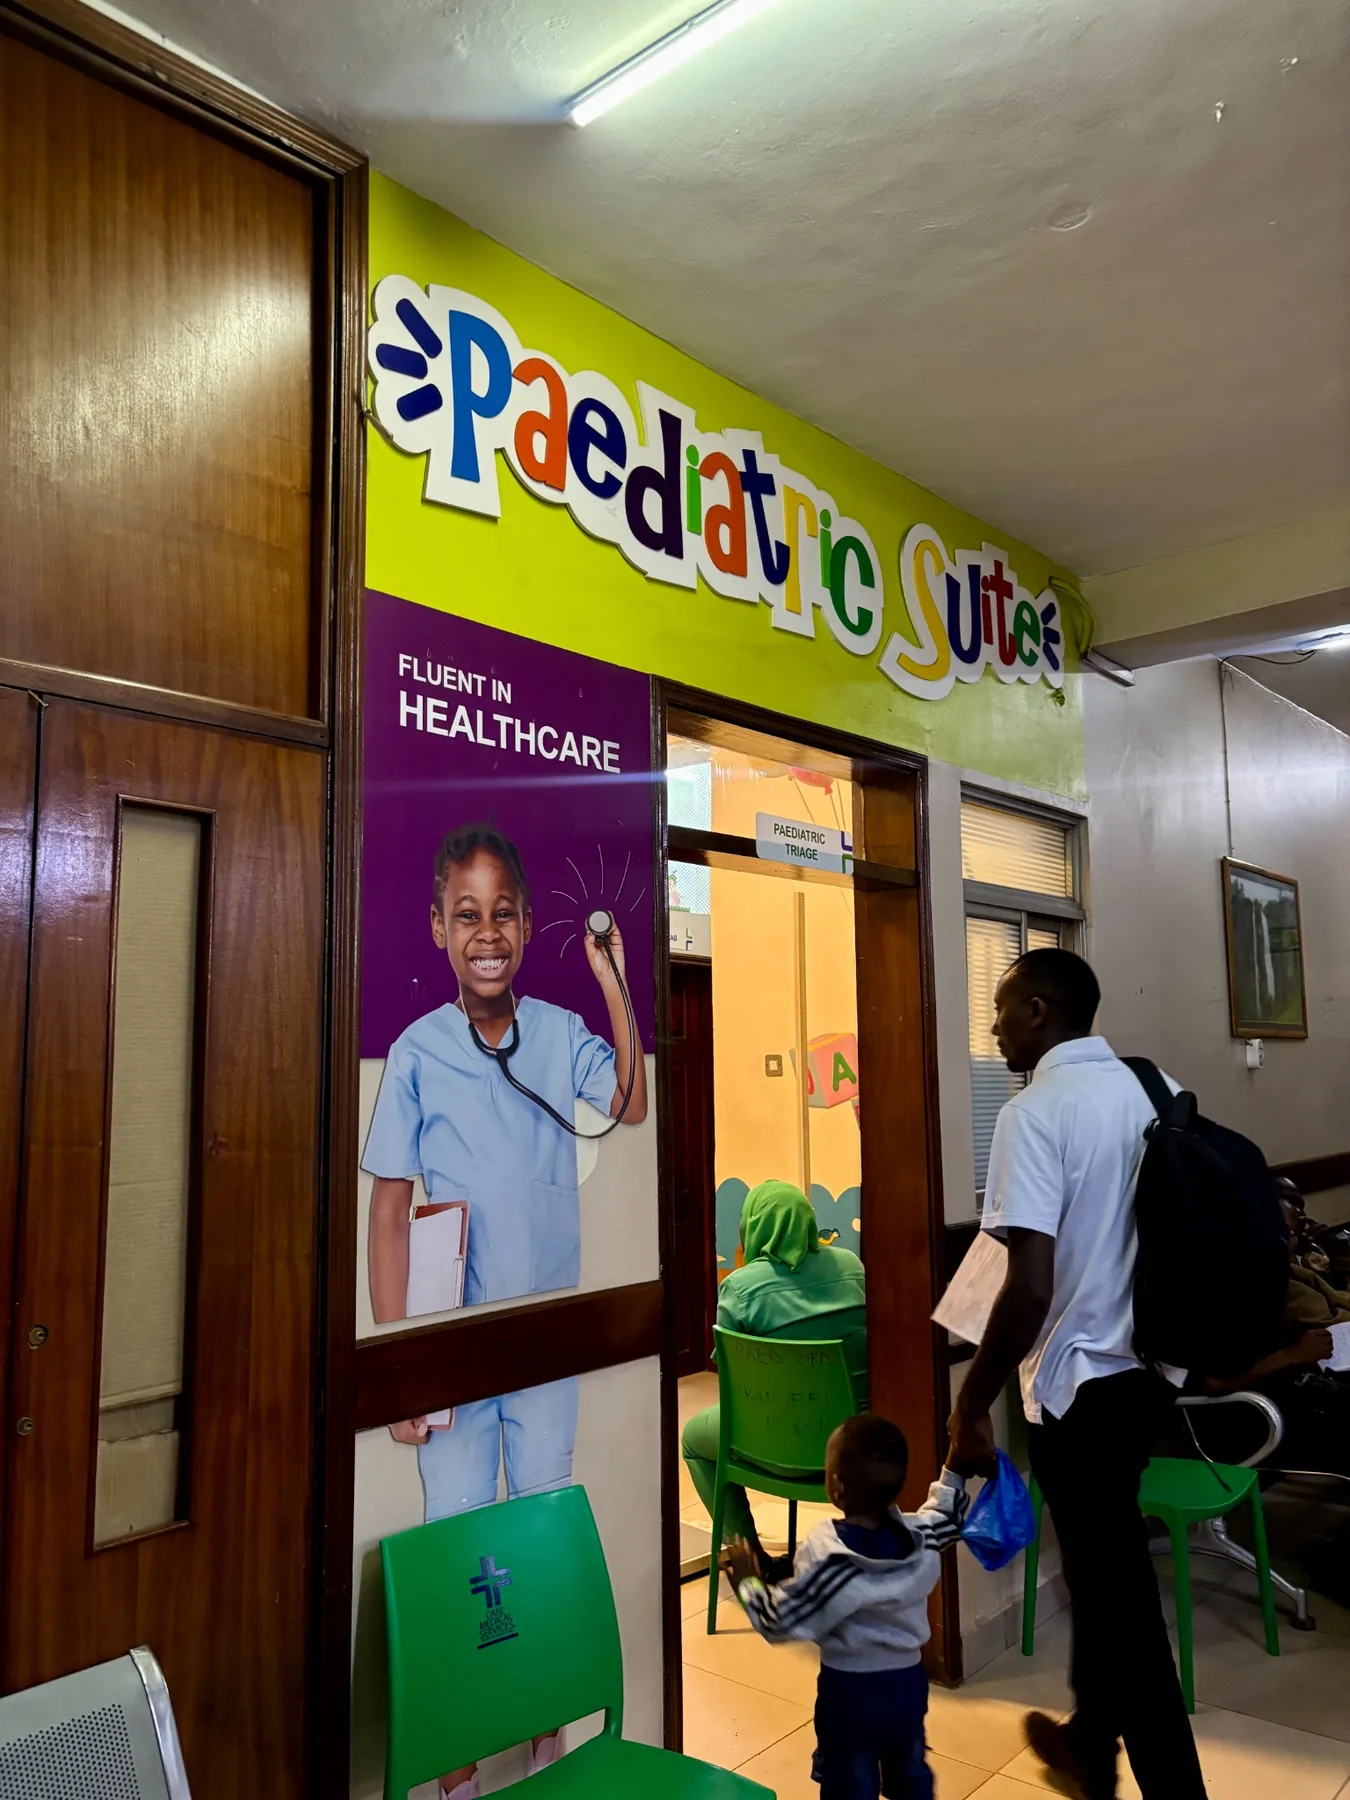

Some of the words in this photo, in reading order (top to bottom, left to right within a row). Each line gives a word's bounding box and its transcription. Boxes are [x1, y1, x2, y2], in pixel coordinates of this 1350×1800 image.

[399, 653, 486, 697] FLUENT
[492, 679, 511, 704] IN
[400, 690, 620, 773] HEALTHCARE
[773, 822, 826, 845] PAEDIATRIC
[785, 843, 818, 861] TRIAGE
[833, 1051, 857, 1092] A
